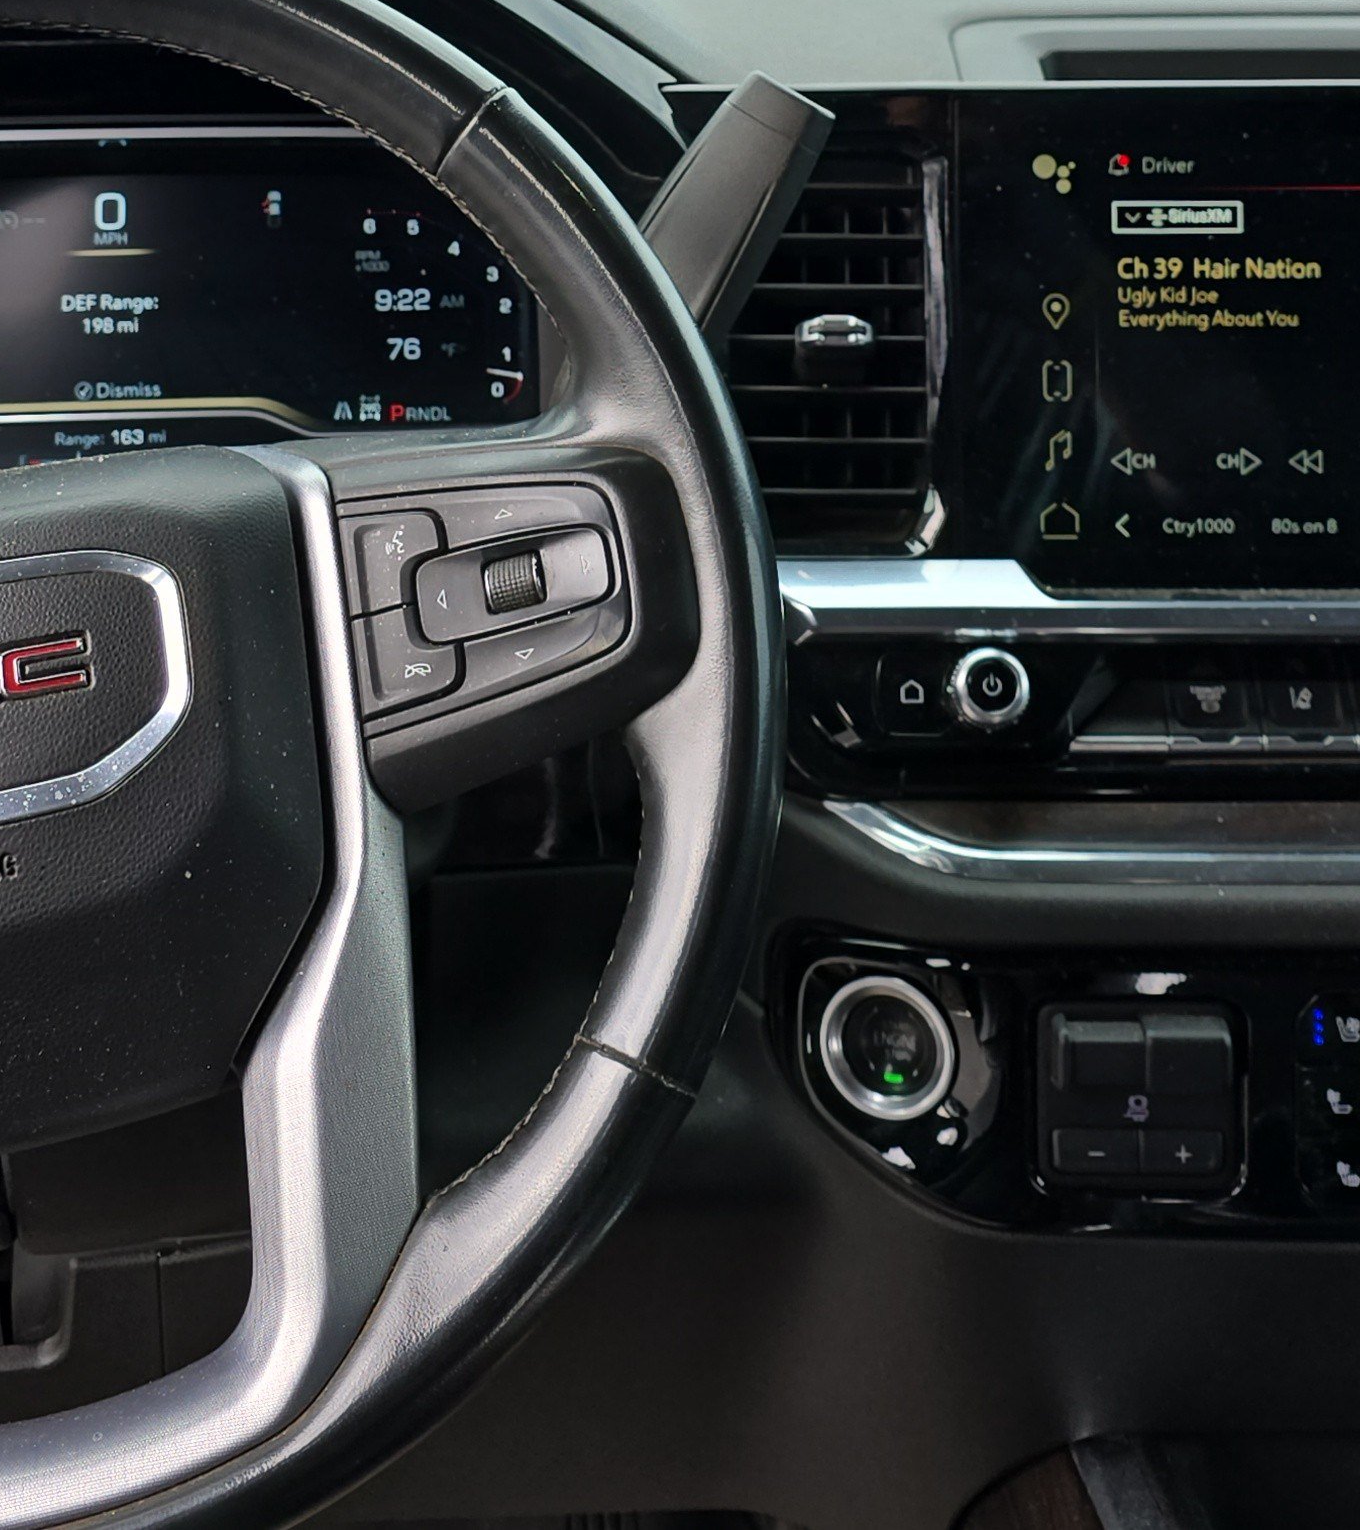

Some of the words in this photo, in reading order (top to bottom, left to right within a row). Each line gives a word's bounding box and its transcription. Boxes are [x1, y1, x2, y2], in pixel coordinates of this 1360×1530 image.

[1142, 156, 1194, 173] Driver
[93, 191, 127, 231] 0
[1168, 207, 1232, 224] SiriusXM
[93, 232, 128, 246] MPH
[447, 240, 460, 257] 4
[486, 266, 499, 283] 3
[1117, 257, 1149, 279] Ch
[1153, 257, 1183, 279] 39
[1193, 257, 1241, 279] Hair
[1245, 257, 1321, 279] Nation
[61, 295, 96, 312] DEF
[99, 295, 159, 315] Range:
[374, 288, 431, 312] 9:22
[440, 294, 465, 309] AM
[1117, 287, 1156, 308] Ugly
[1160, 287, 1187, 304] Kid
[1190, 287, 1219, 306] Joe
[82, 317, 114, 334] 198
[117, 317, 139, 334] mi
[1118, 310, 1209, 331] Everything
[1212, 310, 1263, 327] About
[1266, 310, 1300, 327] You
[387, 337, 421, 360] 76
[502, 346, 512, 363] 1
[96, 381, 162, 399] Dismiss
[491, 381, 505, 398] 0
[54, 429, 105, 447] Range:
[148, 428, 167, 445] mi
[1132, 454, 1155, 470] CH
[1216, 454, 1240, 470] CH
[1162, 517, 1235, 538] Ctry1000
[1272, 518, 1298, 535] 80s
[1302, 521, 1321, 535] on
